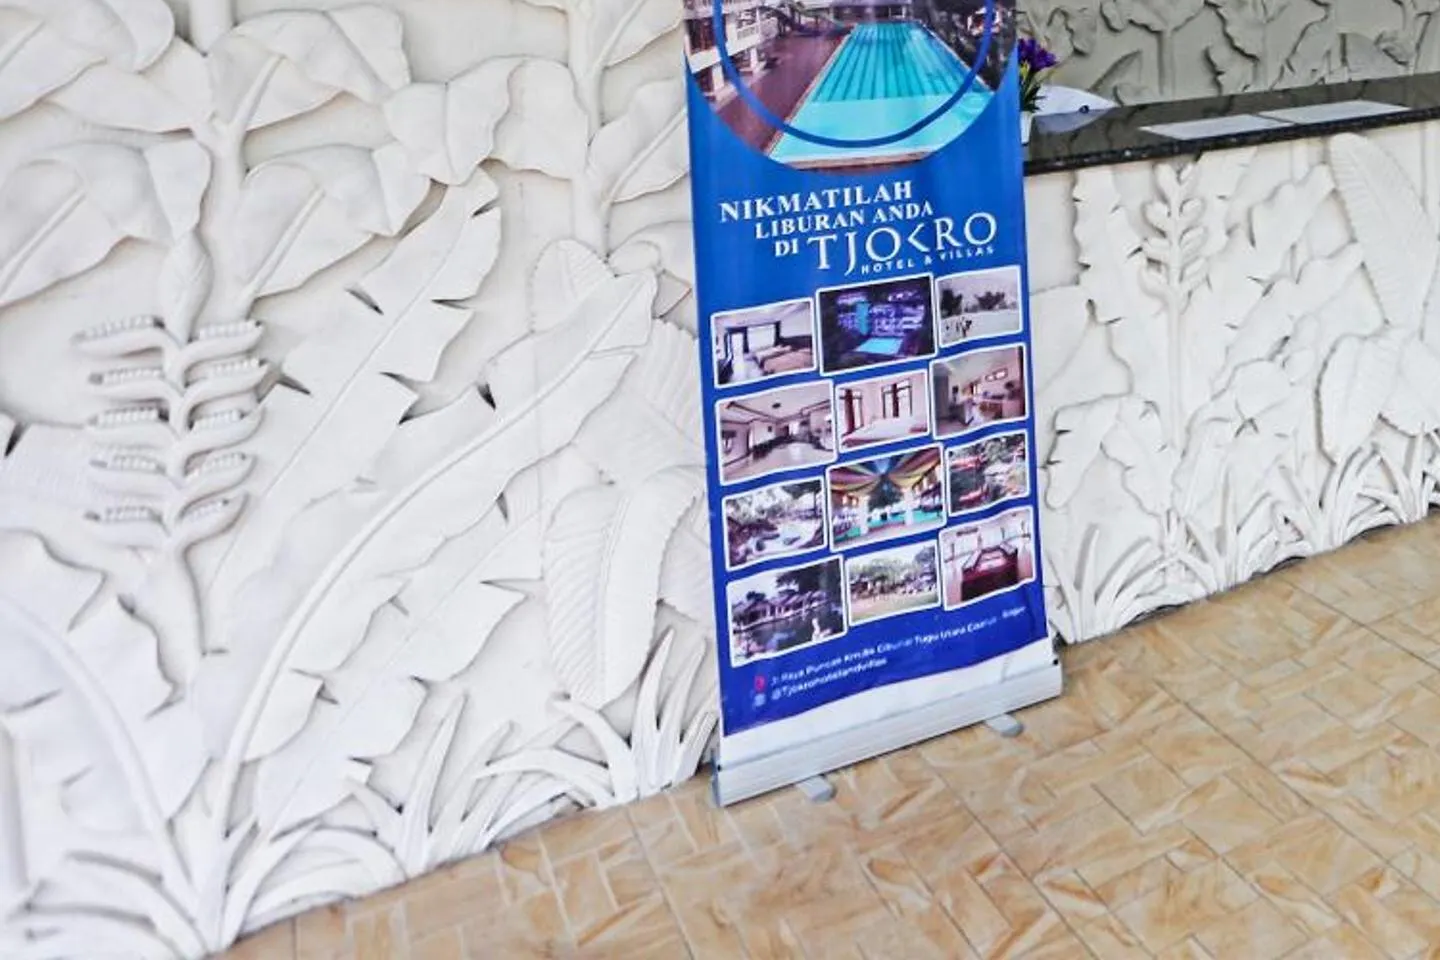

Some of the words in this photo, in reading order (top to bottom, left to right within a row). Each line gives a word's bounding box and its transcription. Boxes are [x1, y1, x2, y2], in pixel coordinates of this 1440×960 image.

[720, 180, 912, 222] NIKMATILAH
[755, 209, 865, 239] LIBURAN
[872, 200, 933, 224] ANDA
[774, 239, 799, 257] DI
[861, 258, 914, 275] HOTEL
[924, 256, 933, 266] &
[939, 245, 995, 261] VILLAS
